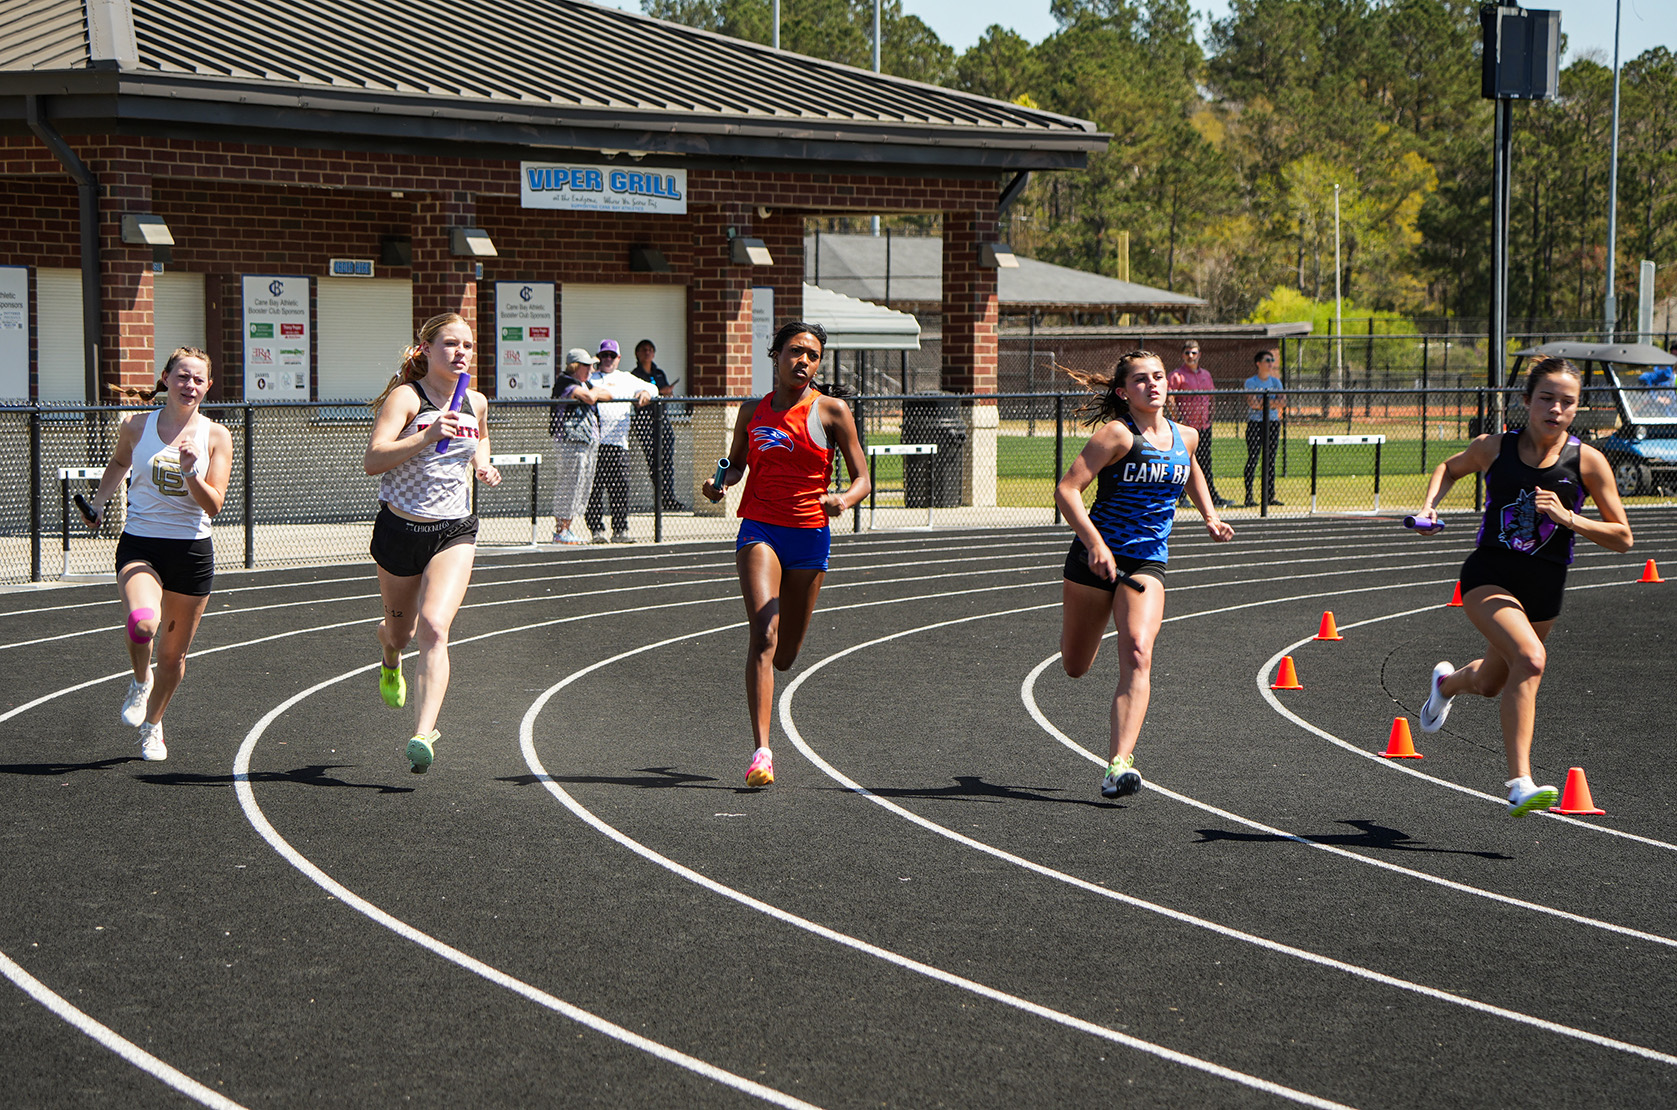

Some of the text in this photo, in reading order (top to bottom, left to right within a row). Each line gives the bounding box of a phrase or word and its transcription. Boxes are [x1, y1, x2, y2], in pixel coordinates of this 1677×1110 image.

[527, 167, 682, 200] VIPER GRILL
[269, 299, 279, 307] Bay
[282, 308, 305, 316] Sponsors
[530, 312, 551, 320] Sponsors
[1123, 462, 1191, 486] CANE BA
